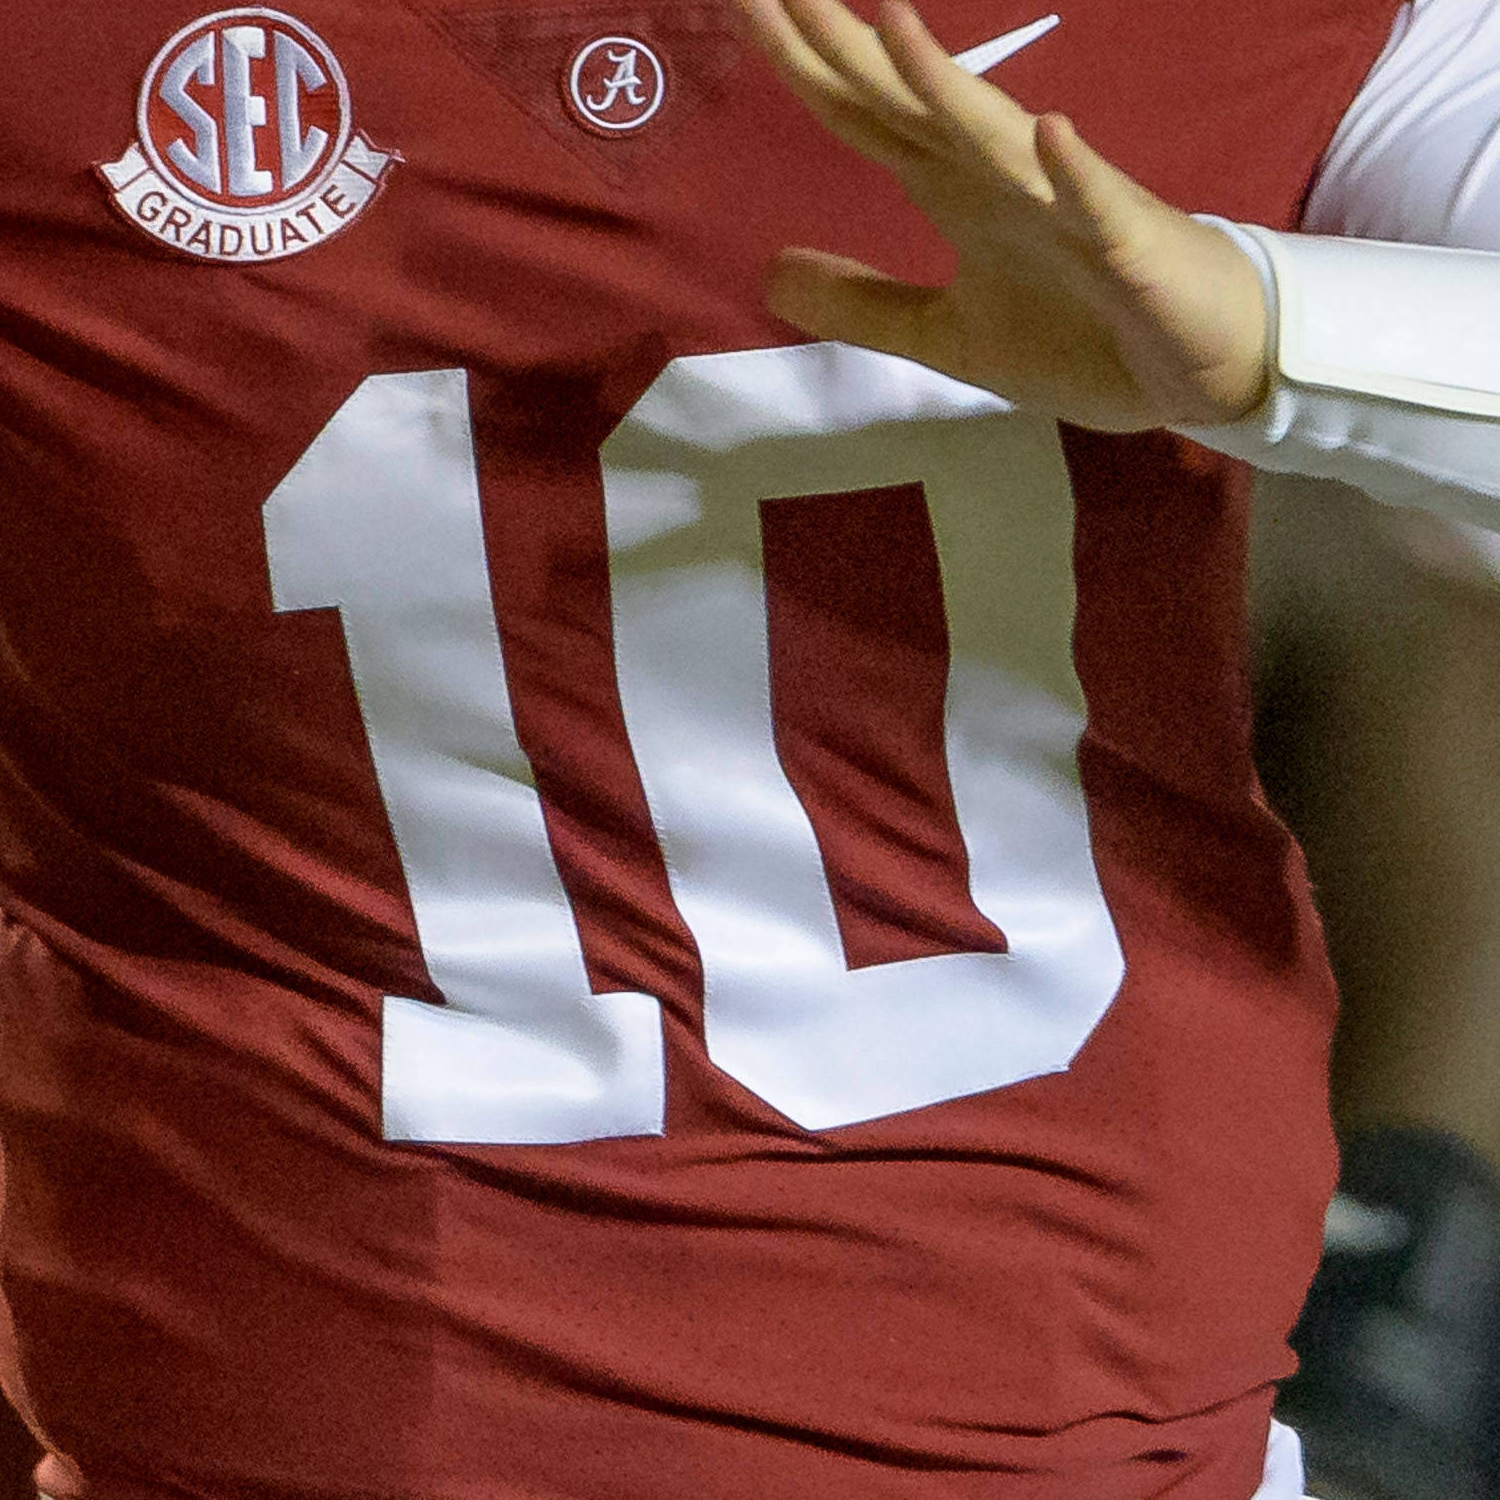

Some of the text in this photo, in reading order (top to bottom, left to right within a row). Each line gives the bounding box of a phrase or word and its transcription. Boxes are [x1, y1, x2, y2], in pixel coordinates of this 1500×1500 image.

[158, 24, 329, 196] SEC
[586, 47, 647, 111] A
[133, 183, 355, 257] GRADUATE
[261, 340, 1126, 1144] 10
